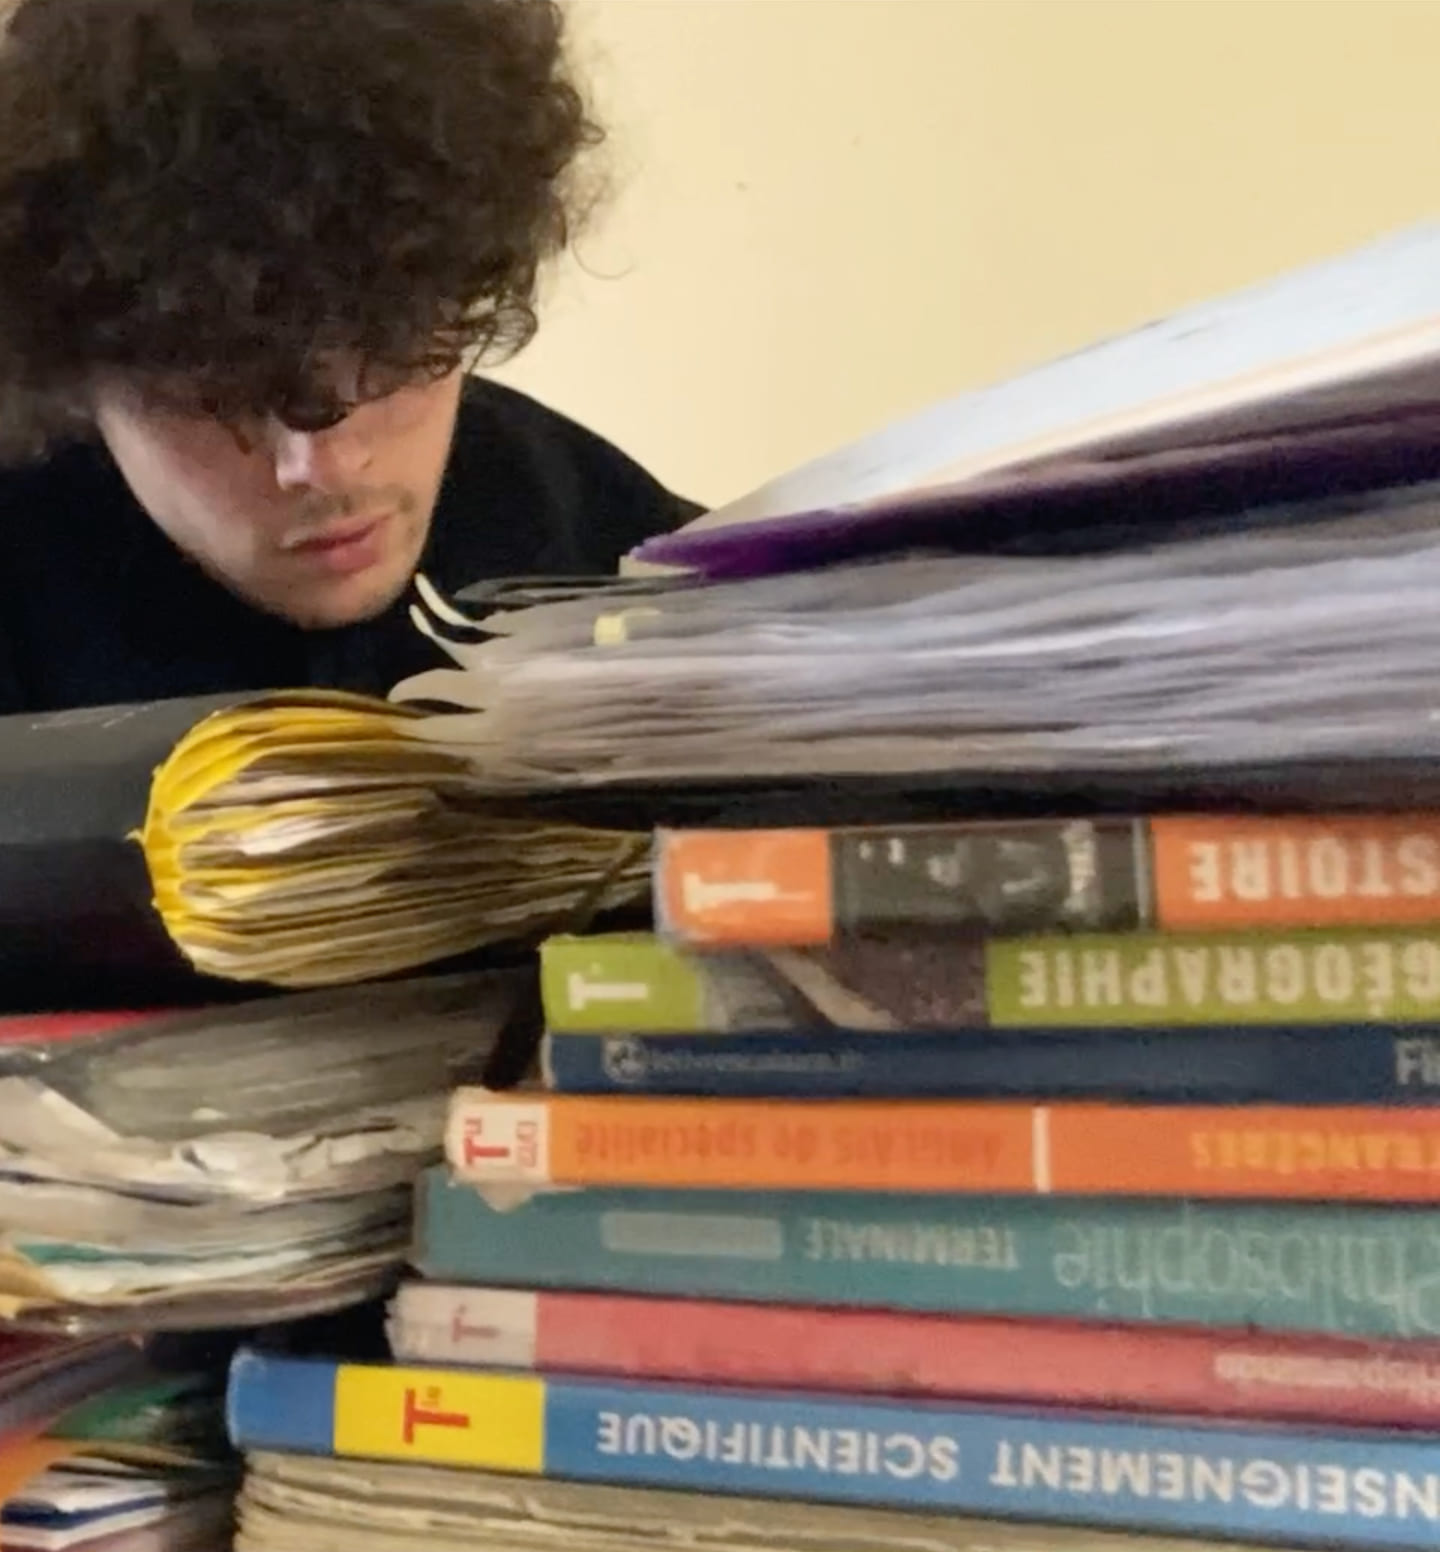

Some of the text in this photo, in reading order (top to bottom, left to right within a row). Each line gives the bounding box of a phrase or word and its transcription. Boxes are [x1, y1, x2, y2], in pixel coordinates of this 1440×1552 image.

[1018, 942, 1440, 1018] GÉOGRAPHIE
[807, 1216, 1020, 1270] TERMINALE
[597, 1412, 958, 1482] SCIENTIFIQUE
